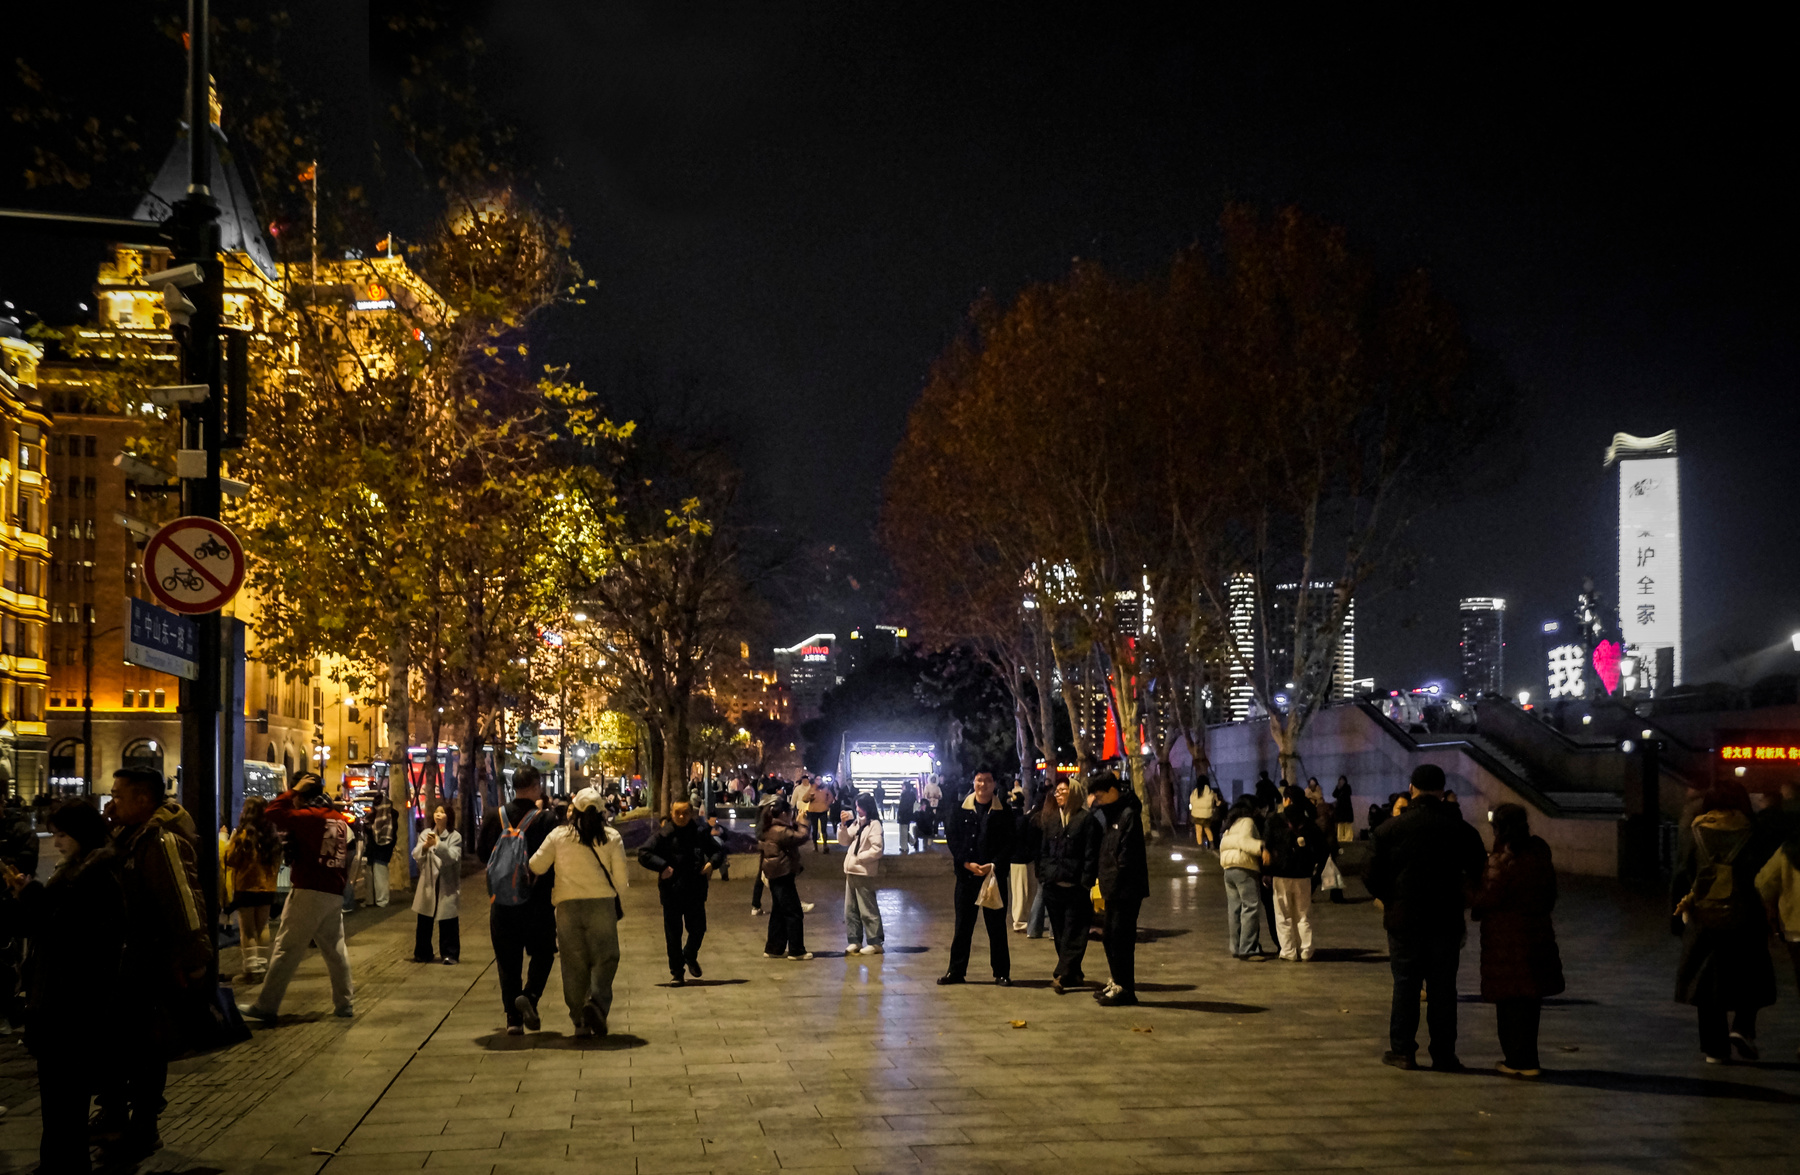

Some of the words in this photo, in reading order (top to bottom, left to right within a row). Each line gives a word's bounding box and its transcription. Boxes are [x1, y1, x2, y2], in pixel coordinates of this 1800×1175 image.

[144, 611, 185, 651] 中山东一路
[1548, 644, 1585, 699] 我
[1722, 746, 1753, 759] 讲文明
[1755, 746, 1787, 760] 树新风
